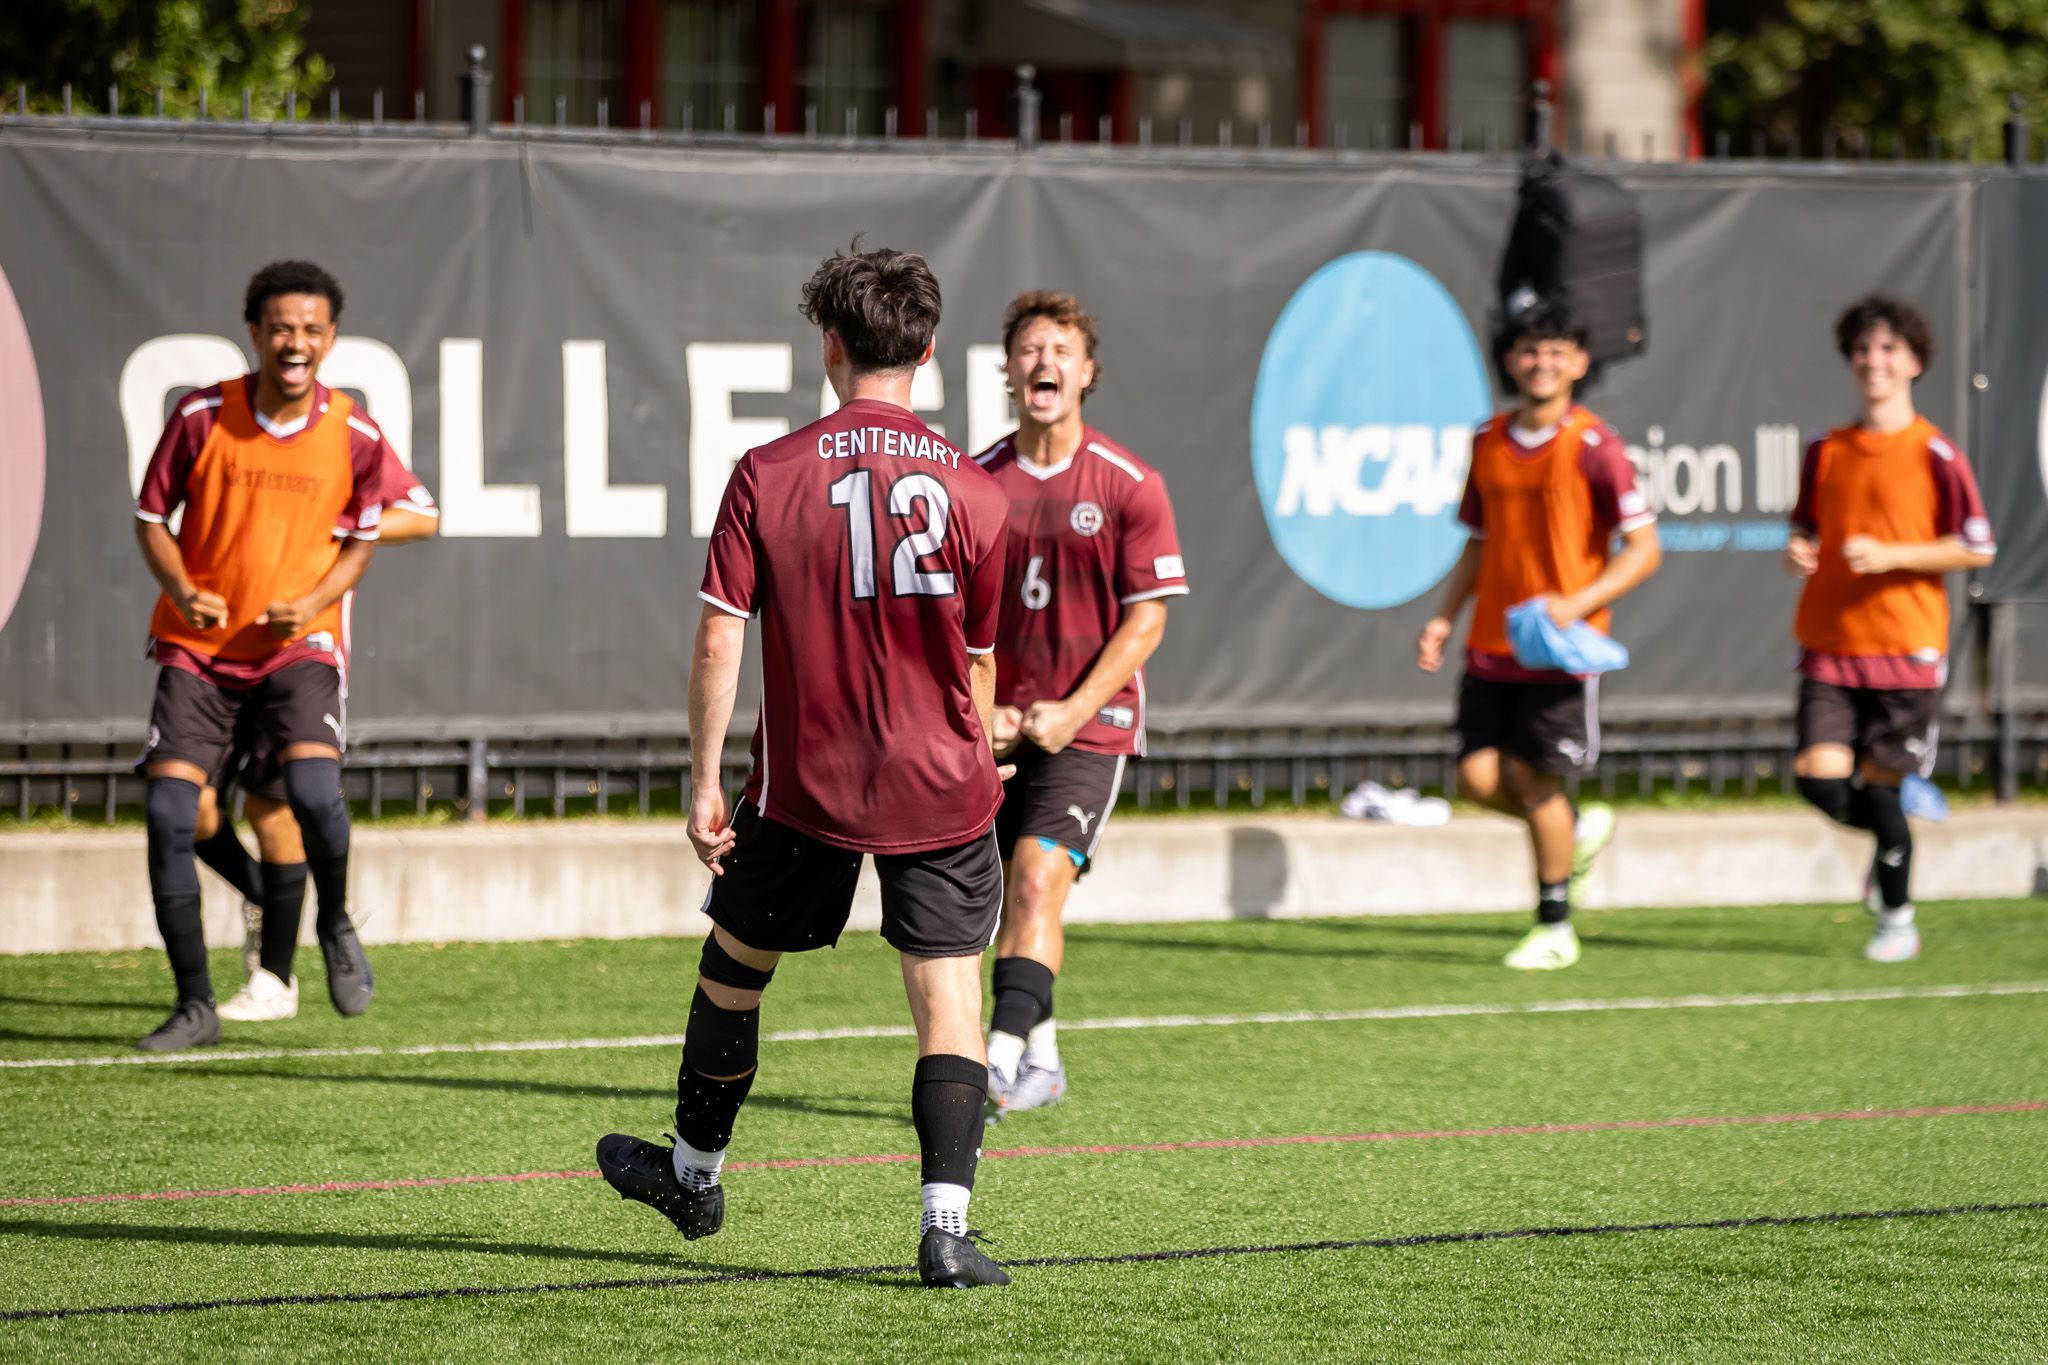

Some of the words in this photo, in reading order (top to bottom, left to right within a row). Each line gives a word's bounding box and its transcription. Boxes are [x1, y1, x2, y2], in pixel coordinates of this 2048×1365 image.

[119, 333, 1021, 537] CLLE
[817, 427, 961, 470] CENTENARY
[1624, 424, 1743, 515] sion
[1756, 424, 1799, 513] III
[828, 467, 958, 600] 12
[1021, 555, 1051, 610] 6
